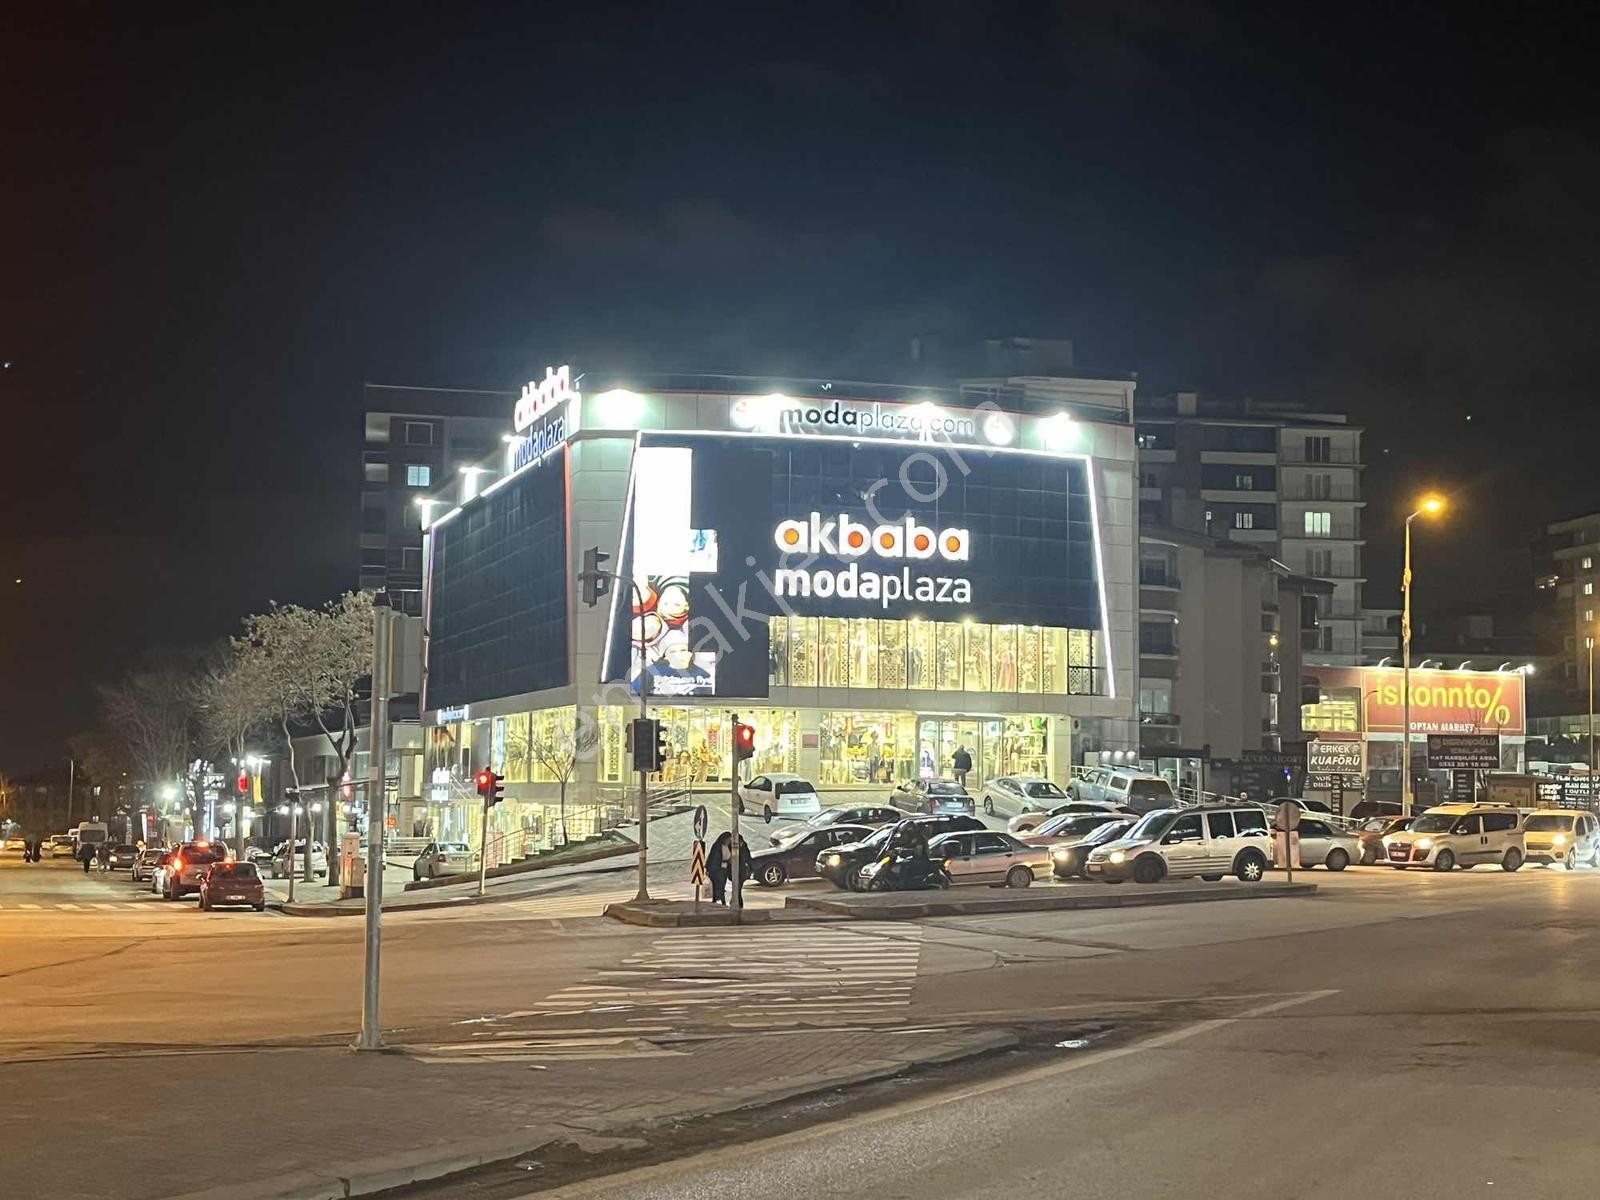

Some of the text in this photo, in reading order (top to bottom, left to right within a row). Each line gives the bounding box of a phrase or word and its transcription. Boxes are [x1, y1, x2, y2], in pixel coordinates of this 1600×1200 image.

[781, 401, 974, 434] modaplazacom
[774, 512, 969, 560] akbaba
[774, 563, 971, 608] modaplaza
[1408, 721, 1439, 731] OPTAN
[1310, 754, 1361, 766] KUAFÖRÜ
[1320, 744, 1350, 754] ERKEK
